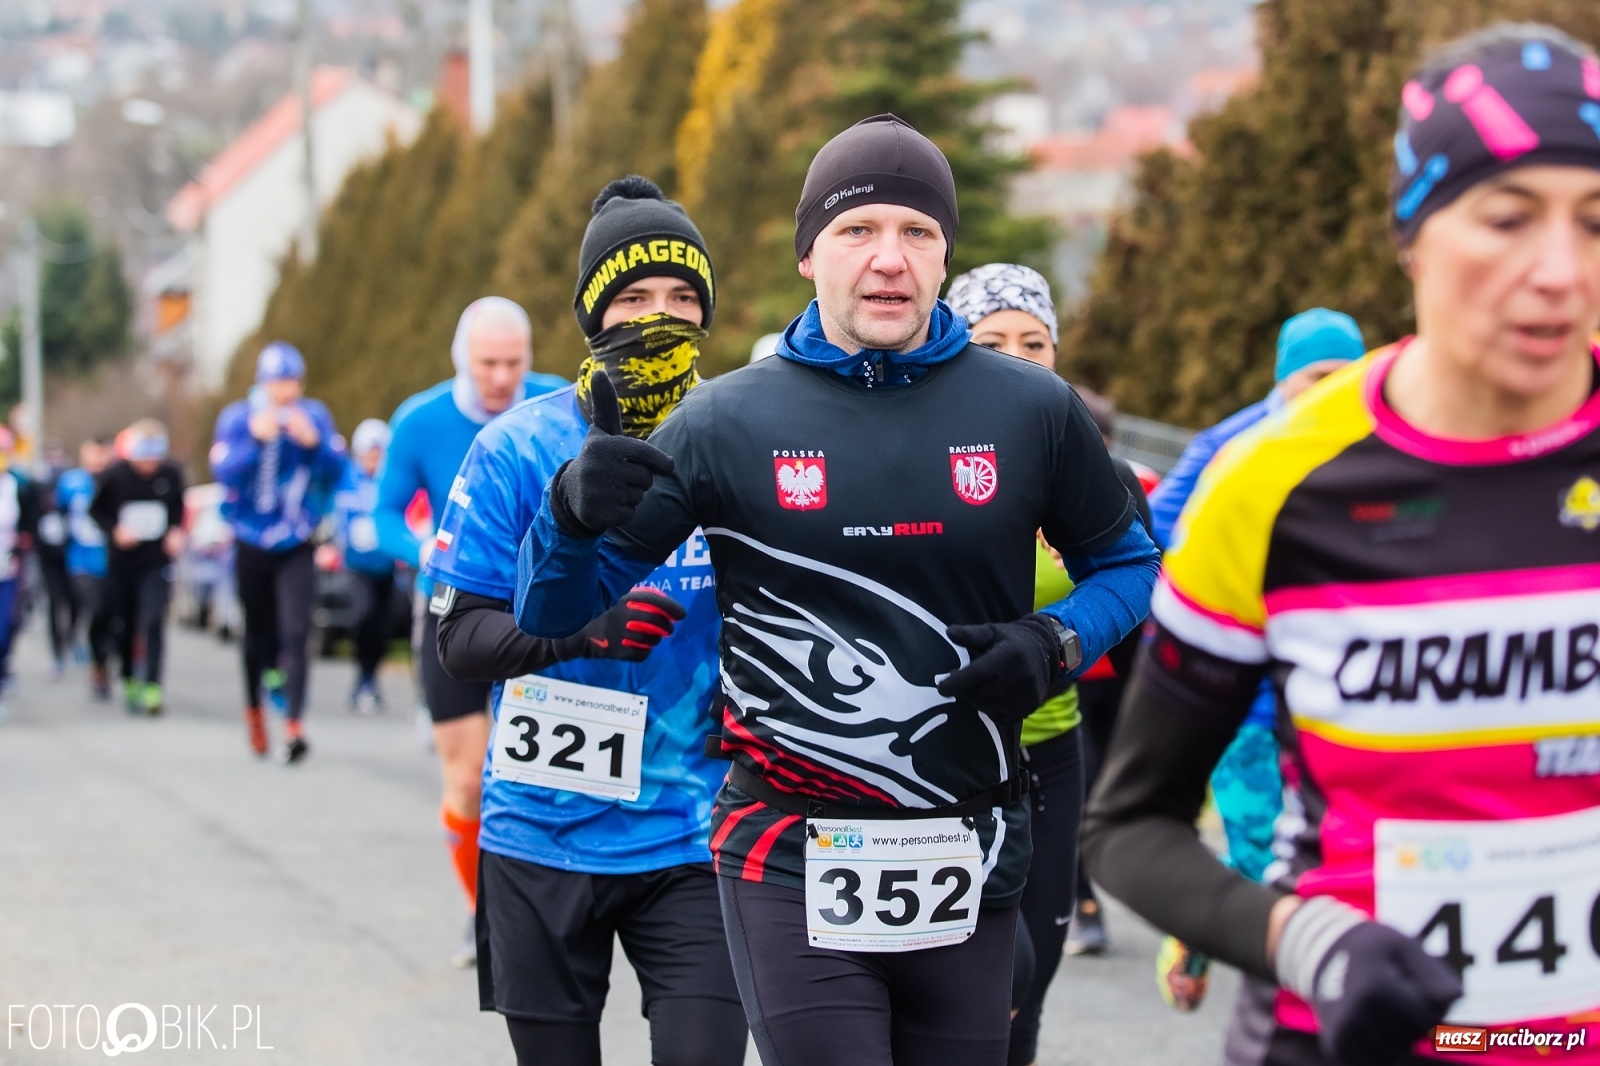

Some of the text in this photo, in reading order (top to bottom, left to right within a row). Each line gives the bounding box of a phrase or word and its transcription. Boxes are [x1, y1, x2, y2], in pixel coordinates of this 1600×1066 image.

[840, 184, 874, 200] Kalenji
[773, 450, 825, 458] POLSKA
[949, 444, 995, 454] RACIBÓRZ
[679, 575, 716, 591] TEA
[554, 694, 641, 717] www.personalbest.pl
[504, 715, 625, 779] 321
[817, 824, 863, 833] PersonalBest
[871, 832, 972, 848] www.personalbest.pl
[817, 866, 973, 927] 352
[1416, 890, 1600, 975] 44
